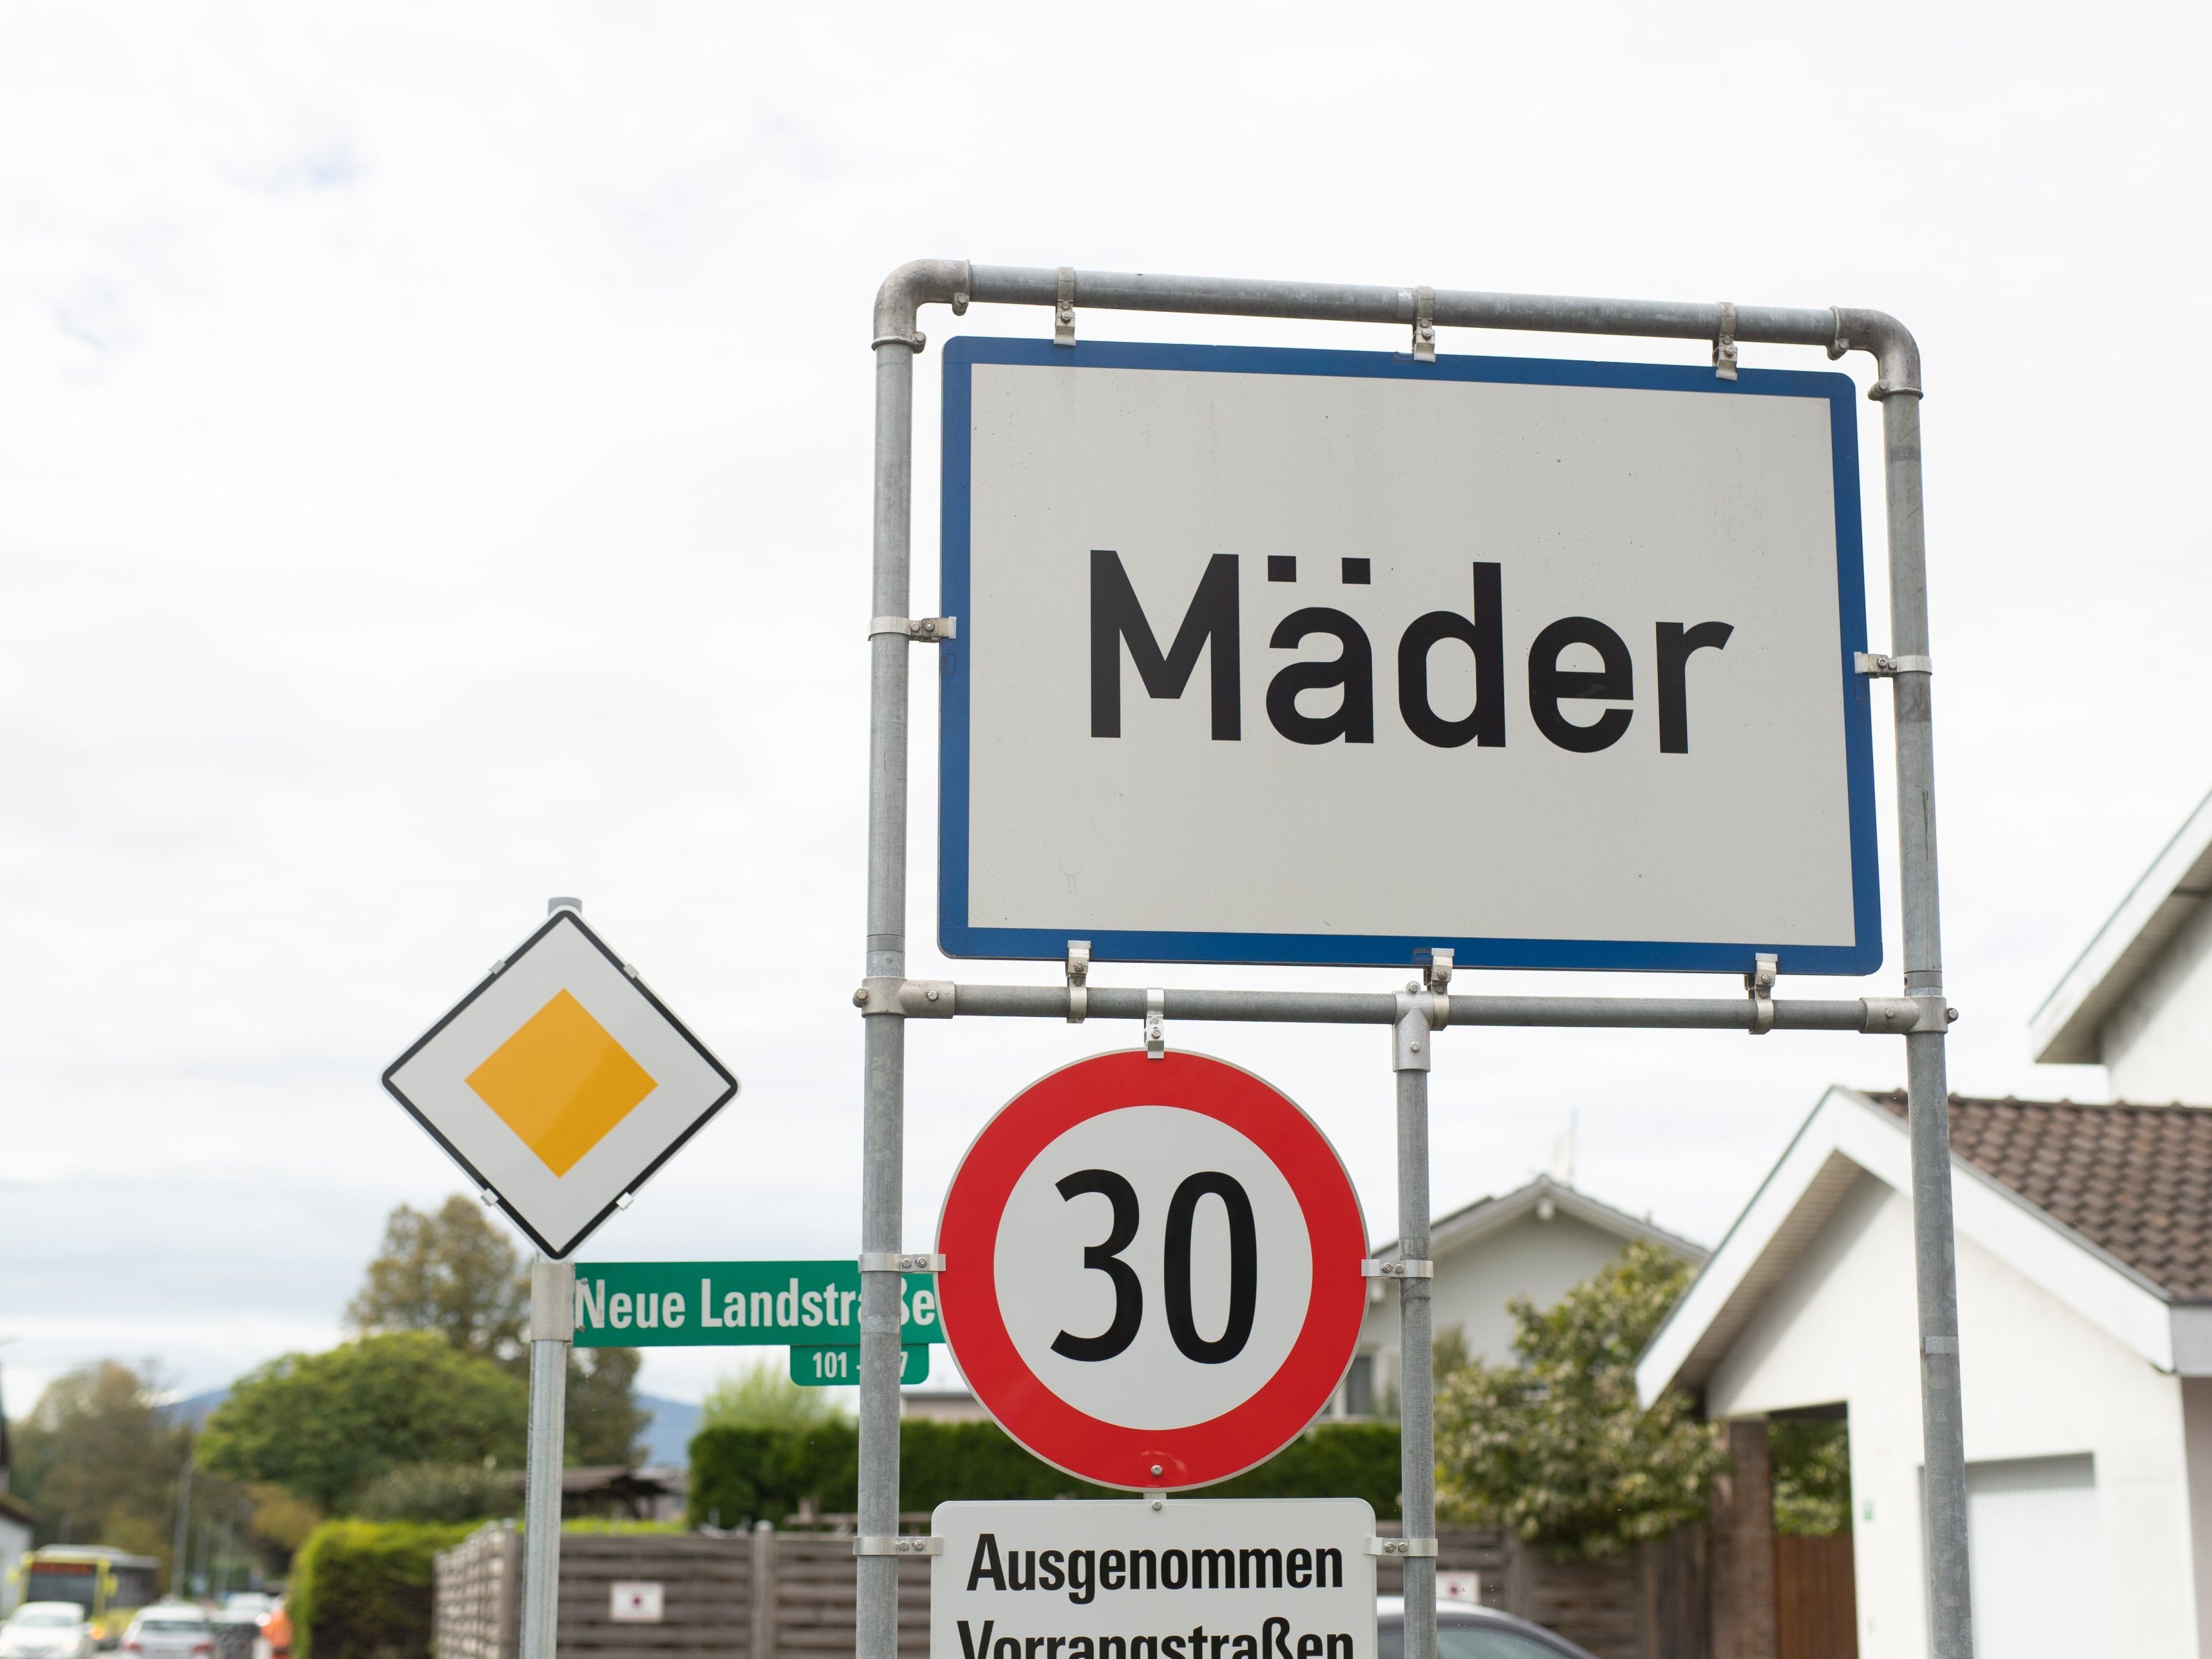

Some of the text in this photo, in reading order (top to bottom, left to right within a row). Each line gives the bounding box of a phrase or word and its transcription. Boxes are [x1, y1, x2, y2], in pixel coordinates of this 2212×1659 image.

[1091, 550, 1734, 753] Mäder
[1050, 1169, 1257, 1364] 30
[575, 1278, 936, 1329] Neue Landstre
[813, 1352, 847, 1378] 101
[967, 1534, 1342, 1604] Ausgenommen
